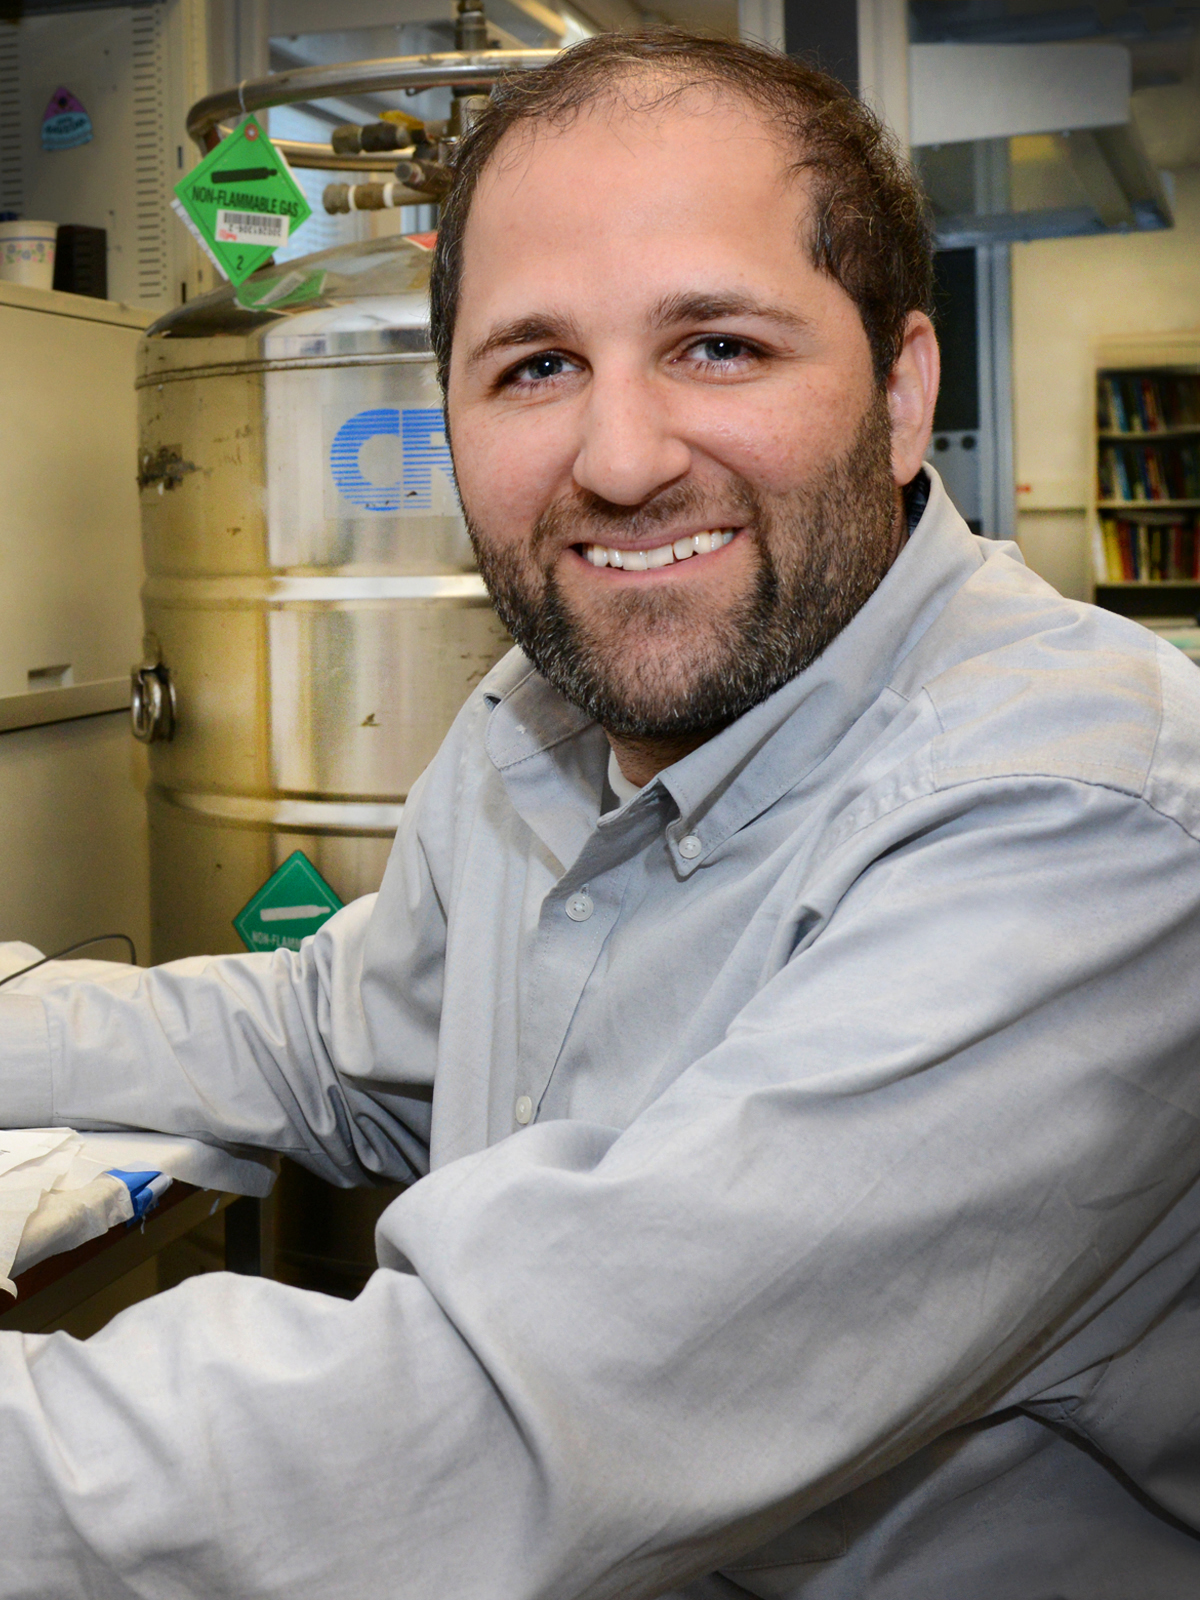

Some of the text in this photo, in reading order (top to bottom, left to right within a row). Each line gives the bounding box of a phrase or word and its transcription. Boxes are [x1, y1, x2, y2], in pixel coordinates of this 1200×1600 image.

[192, 186, 299, 218] NON-FLAMMABLE GAS
[236, 255, 244, 271] 2
